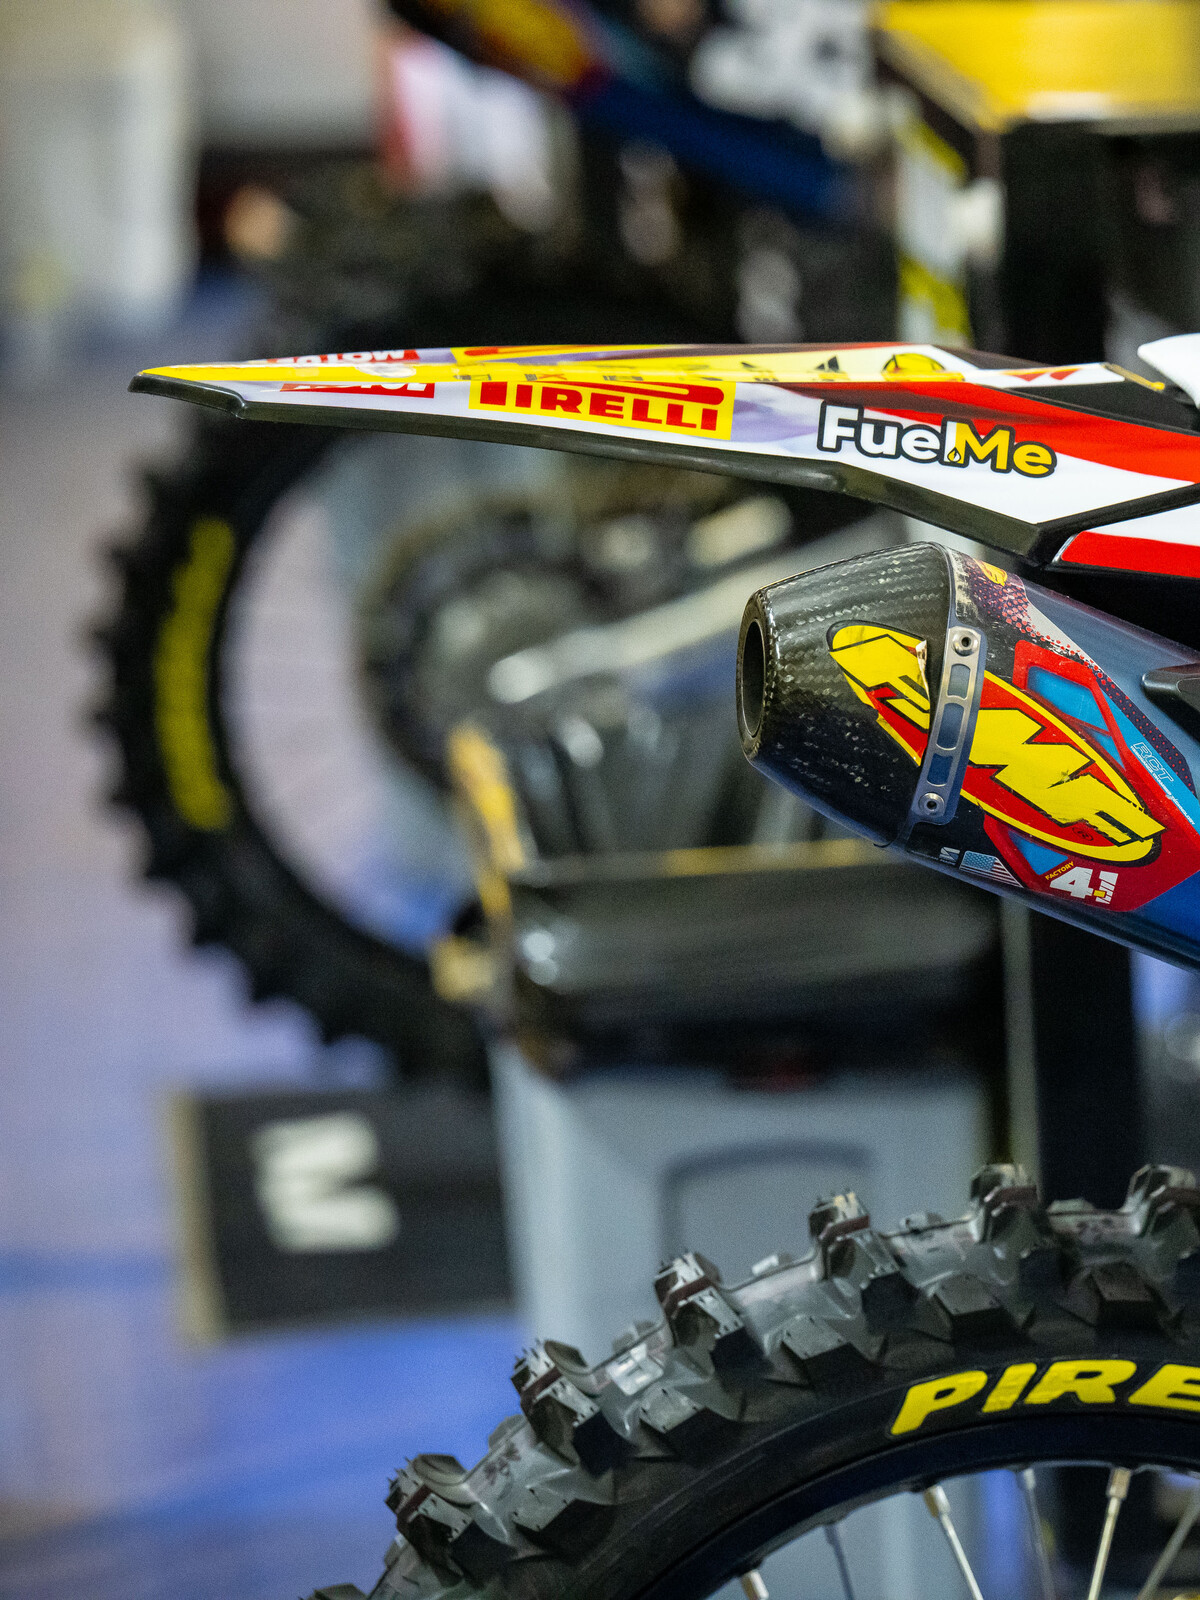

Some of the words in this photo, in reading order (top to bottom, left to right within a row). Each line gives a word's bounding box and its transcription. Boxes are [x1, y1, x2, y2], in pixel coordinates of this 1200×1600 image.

[819, 402, 1055, 476] FuelMe
[1132, 741, 1174, 782] RCT
[1045, 860, 1075, 881] FACTORY
